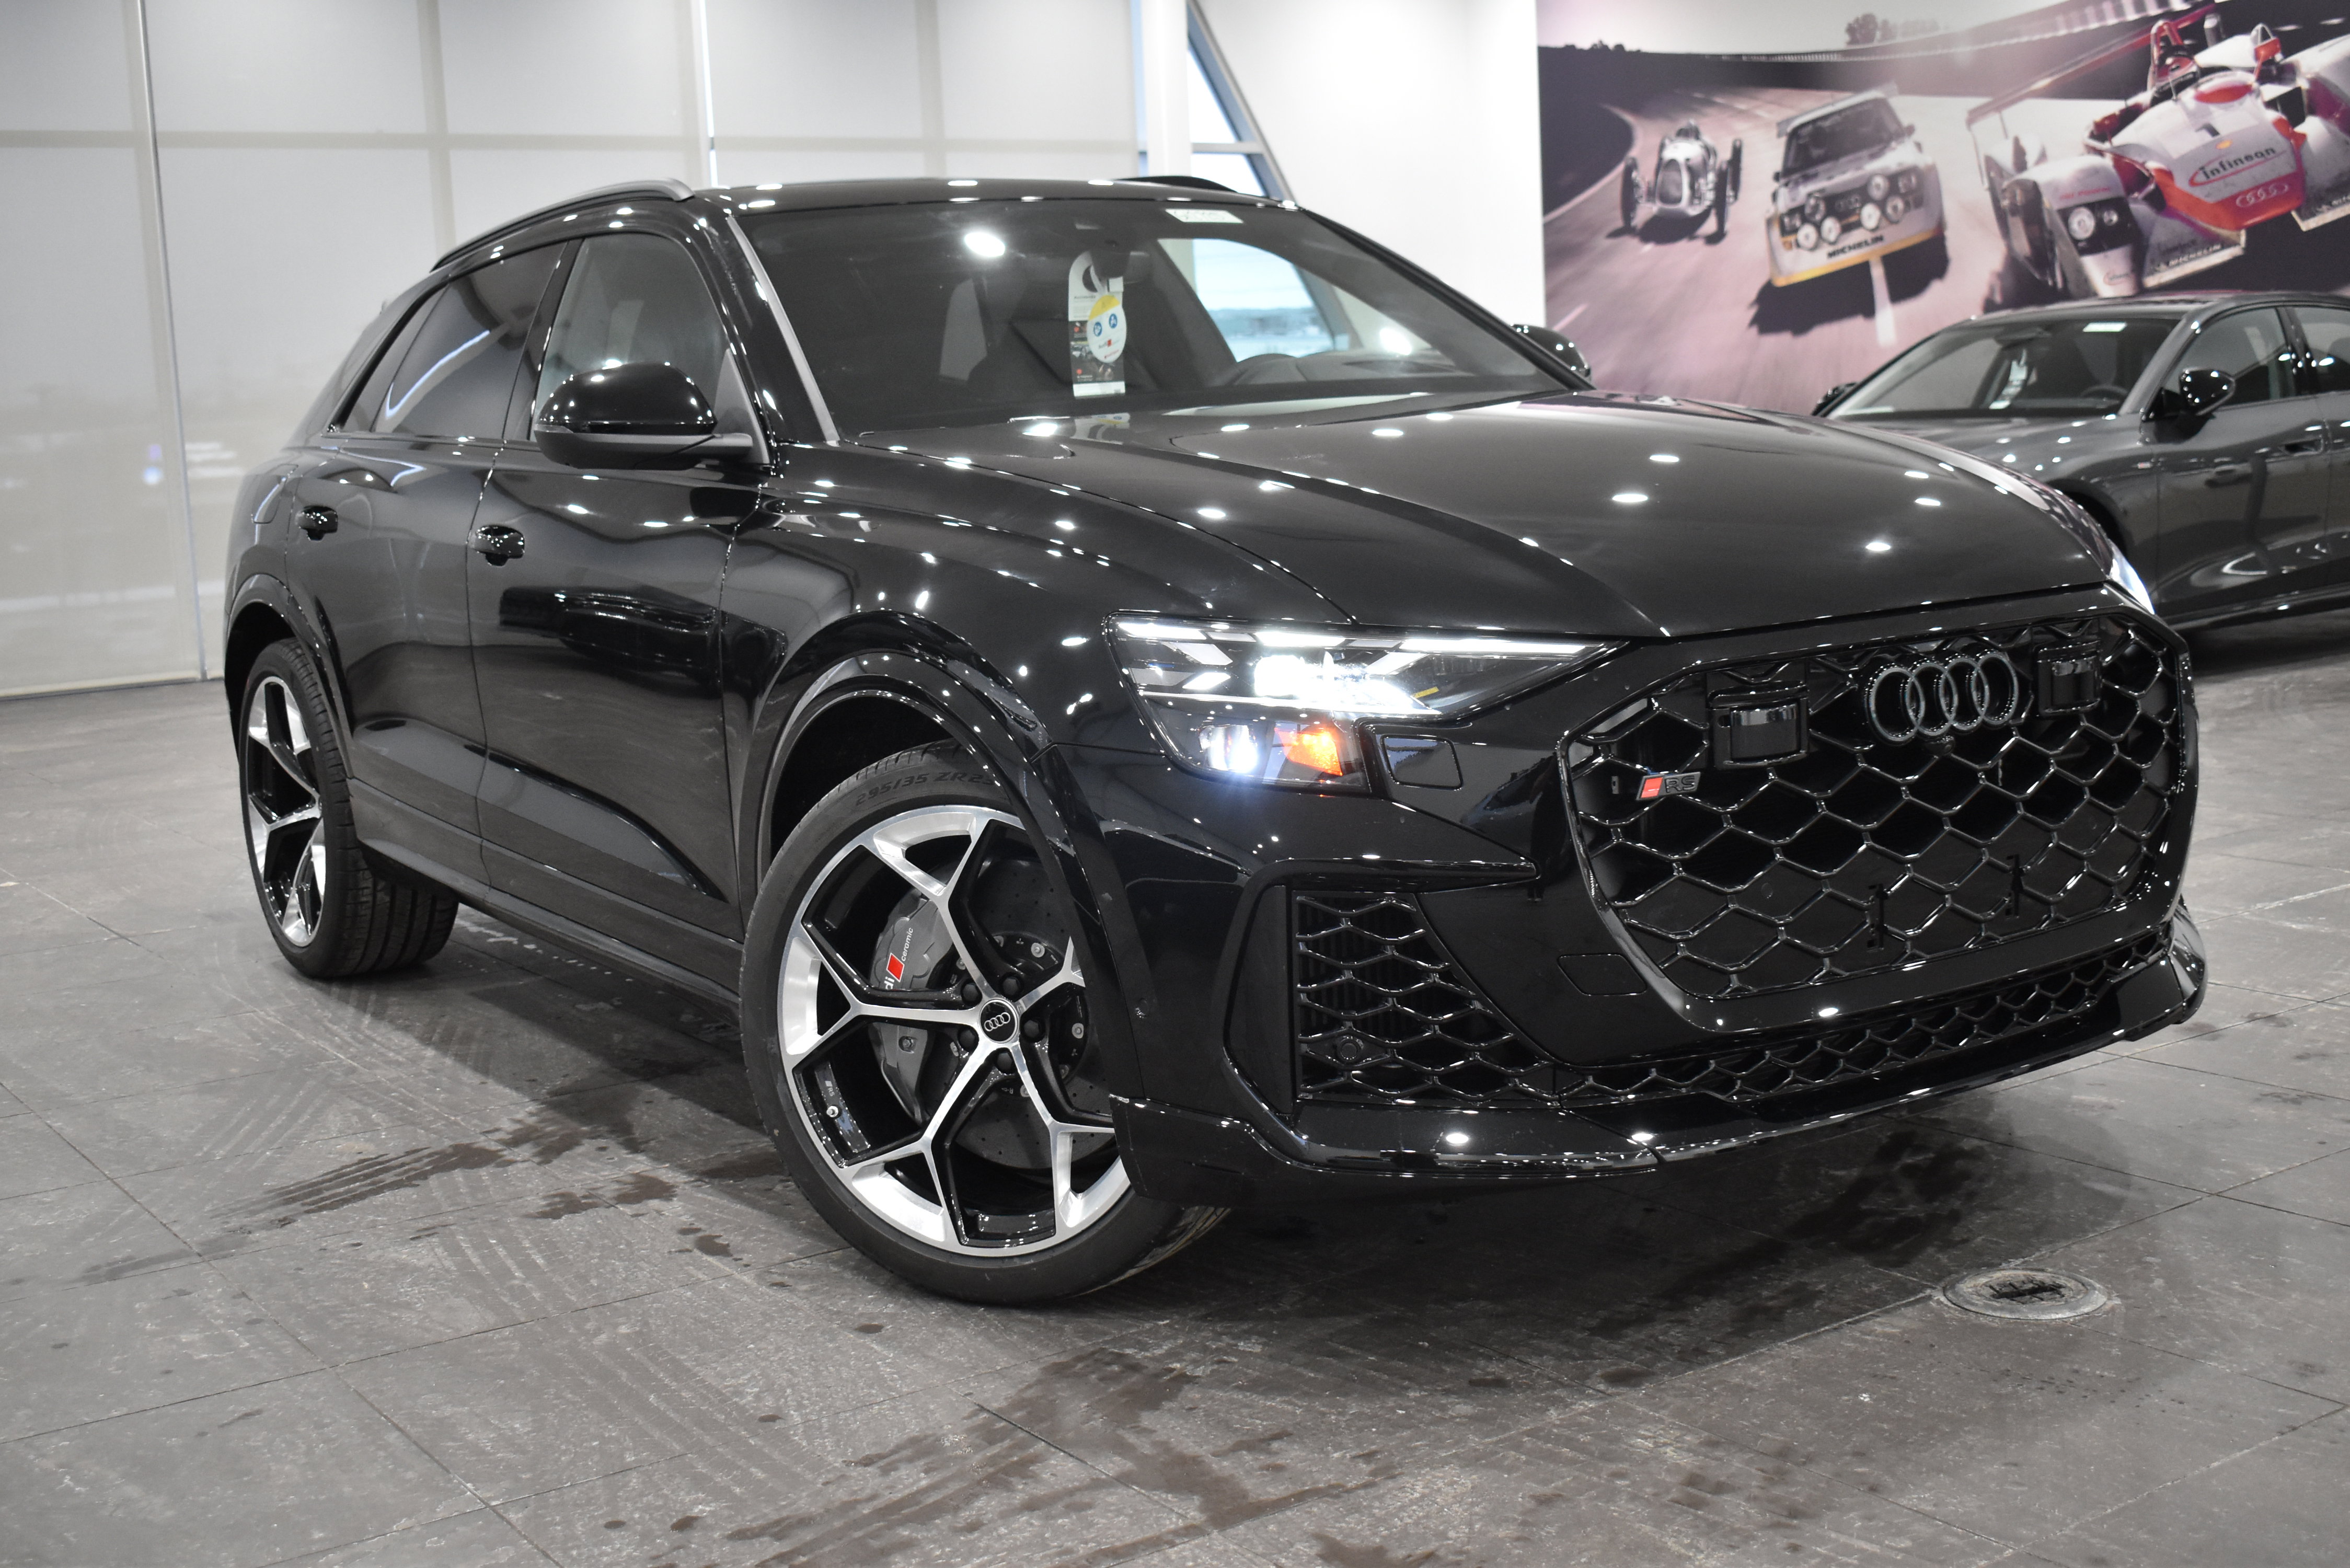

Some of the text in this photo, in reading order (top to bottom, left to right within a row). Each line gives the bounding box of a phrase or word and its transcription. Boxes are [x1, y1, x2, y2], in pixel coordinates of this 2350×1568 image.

[2199, 146, 2276, 179] Infineon
[1827, 236, 1883, 258] MICHELIN
[856, 773, 929, 806] 295/35
[1664, 775, 1696, 793] RS
[901, 927, 914, 962] ceramic
[828, 1087, 835, 1097] RS
